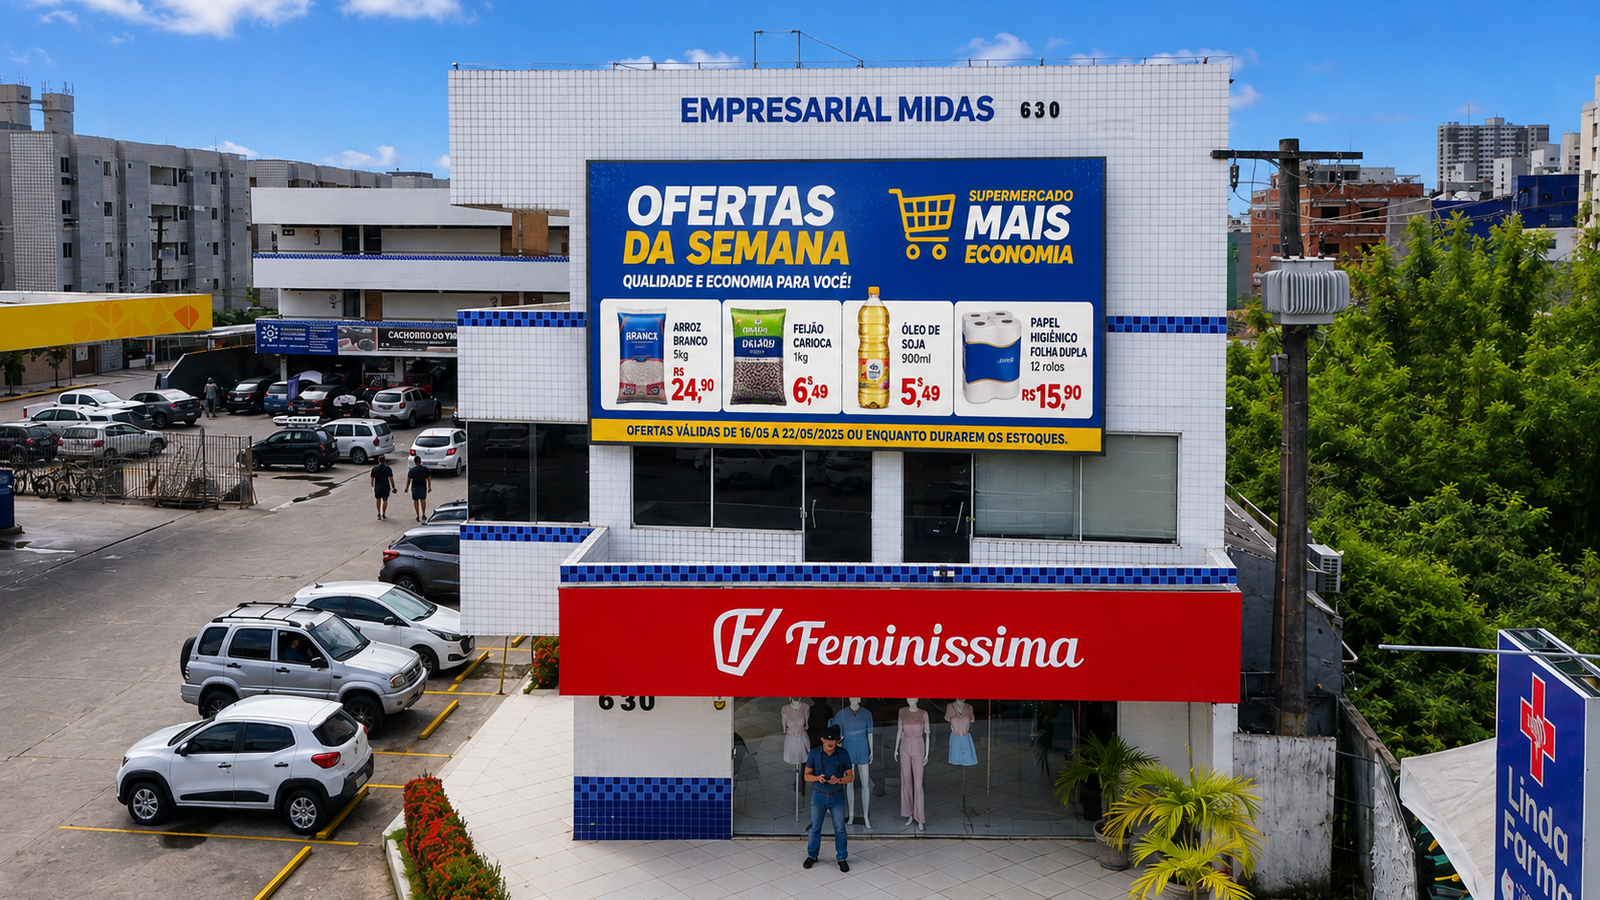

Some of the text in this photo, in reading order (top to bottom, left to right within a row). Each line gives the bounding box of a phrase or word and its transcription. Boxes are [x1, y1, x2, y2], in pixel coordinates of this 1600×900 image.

[681, 95, 1059, 123] EMPRESARIAL MIDAS 630
[969, 190, 1073, 201] SUPERMERCADO
[628, 185, 835, 226] OFERTAS
[965, 204, 1071, 240] MAIS
[623, 230, 849, 265] DA SEMANA
[965, 244, 1073, 264] ECONOMIA
[623, 275, 693, 289] QUALIDADE
[696, 275, 703, 287] E
[706, 275, 773, 288] ECONOMIA
[777, 275, 810, 288] PARA
[673, 322, 701, 332] ARROZ
[794, 322, 823, 334] FEIJÃO
[902, 322, 940, 335] ÓLEO DE
[1031, 317, 1060, 328] PAPEL
[674, 336, 707, 346] BRANCO
[793, 338, 831, 348] CARIOCA
[902, 339, 925, 349] SOJA
[674, 349, 688, 362] 5kg
[794, 352, 809, 365] 1kg
[902, 353, 931, 363] 900ml
[1031, 347, 1087, 357] FOLHA DUPLA
[1031, 361, 1064, 371] 12 rolos
[627, 423, 1068, 445] OFERTAS VÁLIDAS DE 16/05 A 22/05/2025 OU ENQUANTO DURAREM OS ESTOQUES.
[786, 621, 1084, 668] Feminissima
[1508, 765, 1568, 867] Linda
